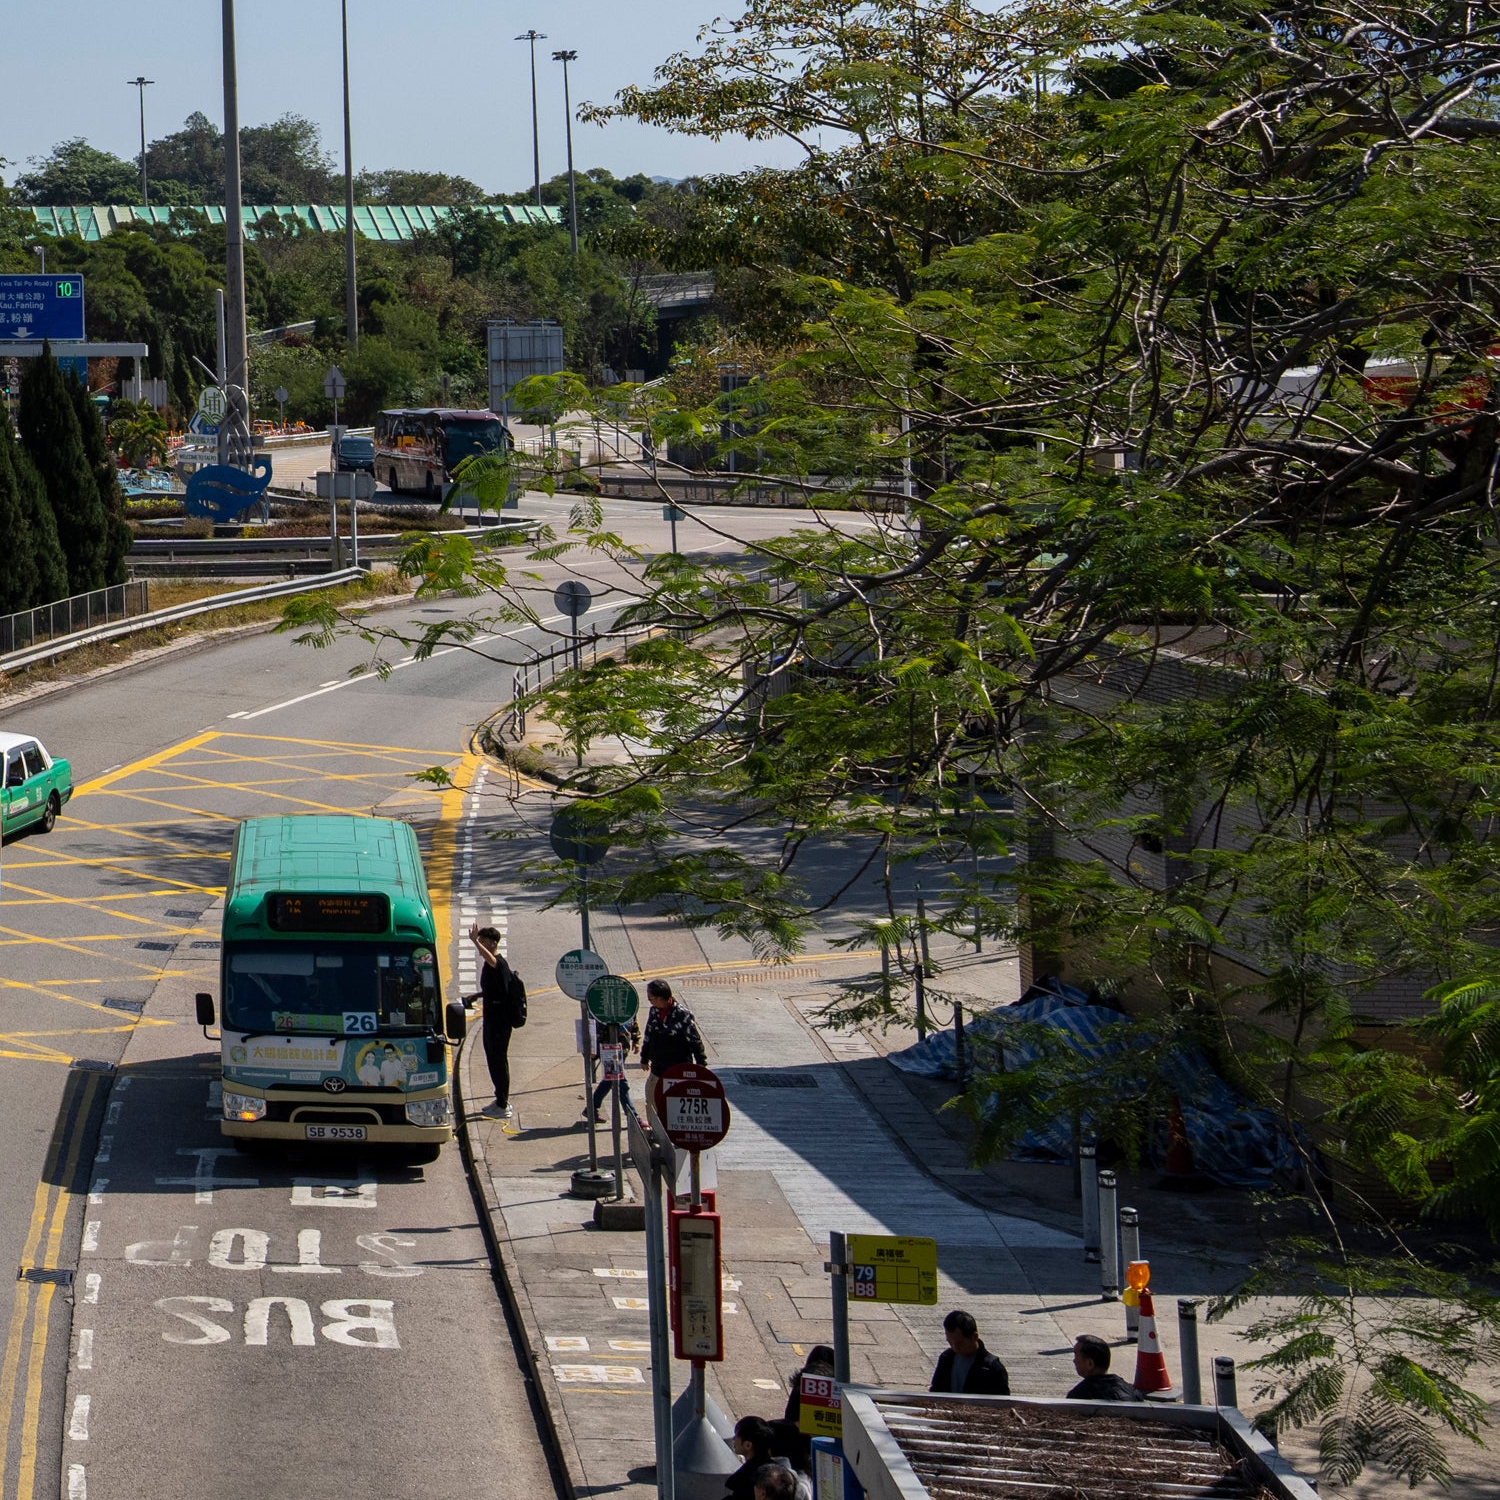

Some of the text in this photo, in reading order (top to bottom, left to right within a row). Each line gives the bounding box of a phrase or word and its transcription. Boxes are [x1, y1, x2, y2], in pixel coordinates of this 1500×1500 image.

[58, 282, 72, 297] 10
[278, 1016, 294, 1029] 26
[345, 1014, 375, 1032] 26
[680, 1098, 709, 1115] 275R
[309, 1127, 363, 1139] SB 9538
[124, 1225, 425, 1278] STOP
[856, 1265, 875, 1281] 79
[856, 1282, 876, 1298] B8
[153, 1295, 402, 1350] BUS
[804, 1379, 830, 1396] B8
